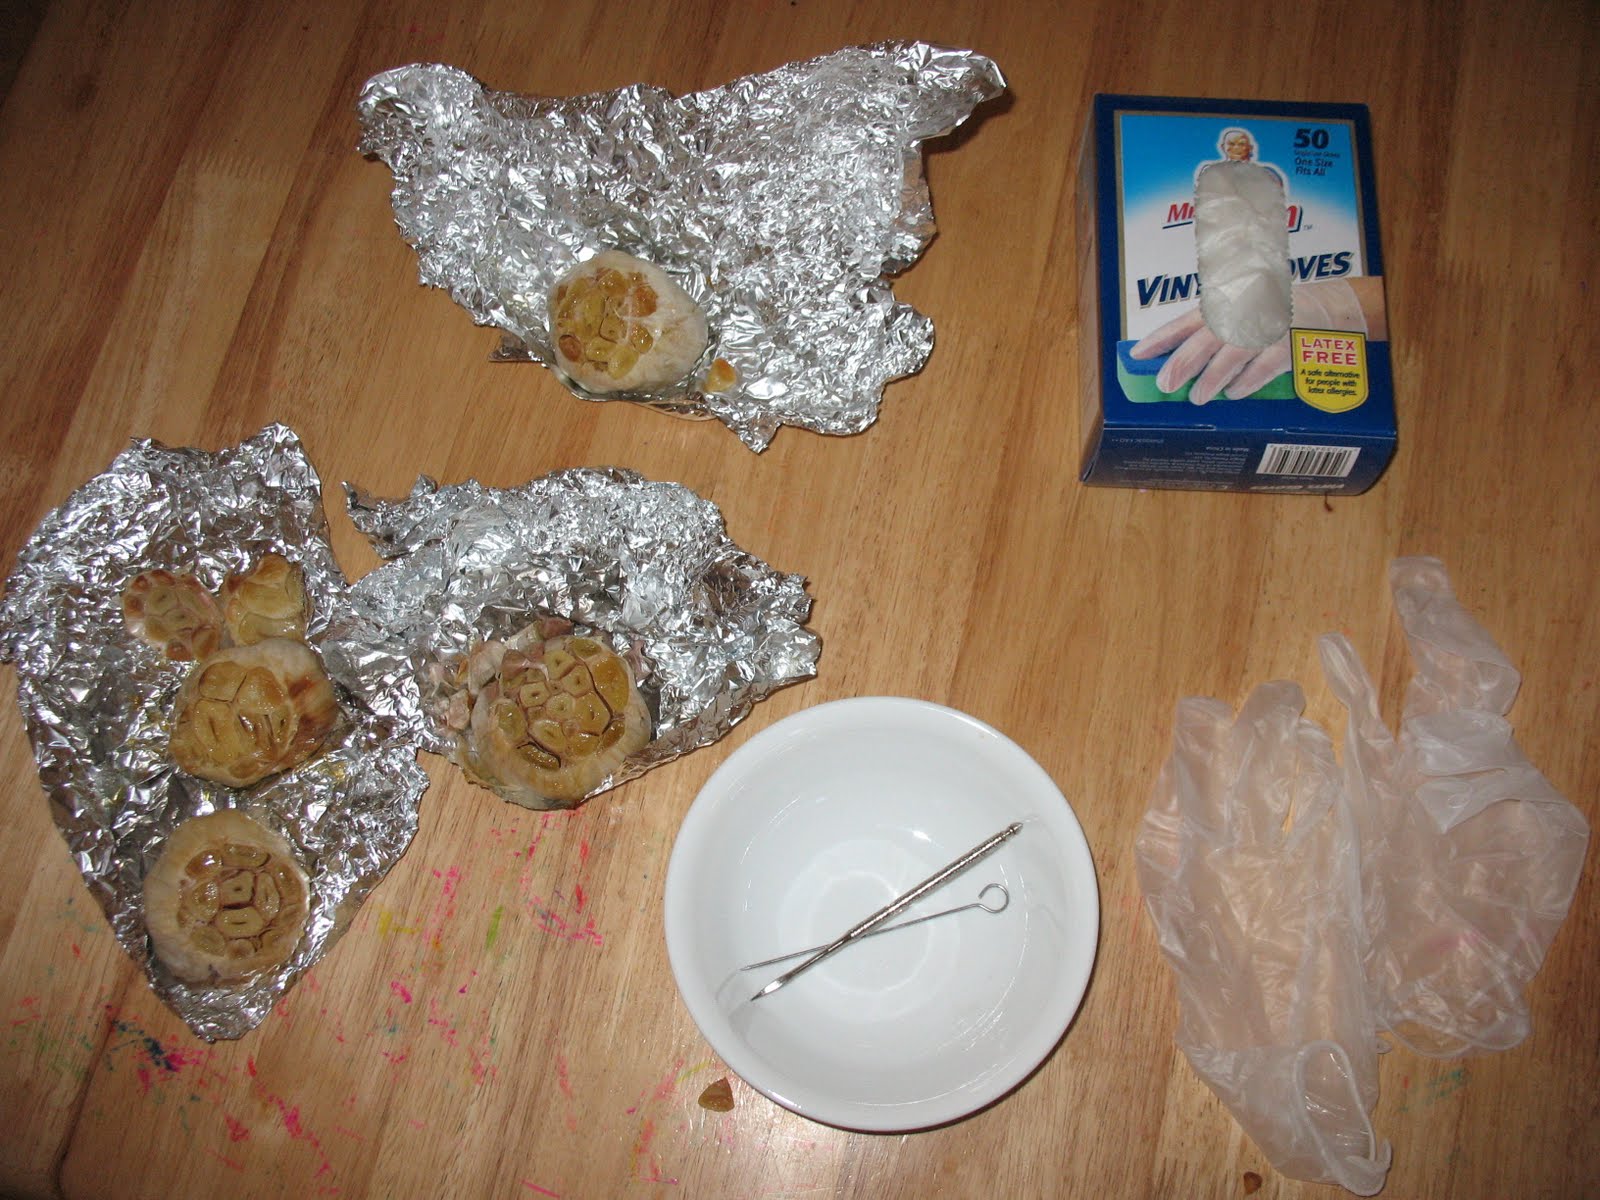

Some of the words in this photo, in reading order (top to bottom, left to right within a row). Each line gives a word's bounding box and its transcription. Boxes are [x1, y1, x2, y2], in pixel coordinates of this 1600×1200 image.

[1294, 128, 1330, 150] 50
[1295, 157, 1312, 166] One
[1314, 158, 1333, 168] Size
[1296, 167, 1311, 175] Fits
[1313, 167, 1326, 176] All
[1137, 273, 1201, 307] VINY
[1301, 338, 1355, 351] LATEX
[1302, 350, 1357, 366] FREE
[1324, 370, 1360, 379] alternative
[1305, 377, 1314, 385] for
[1316, 378, 1341, 387] people
[1308, 386, 1324, 394] latex
